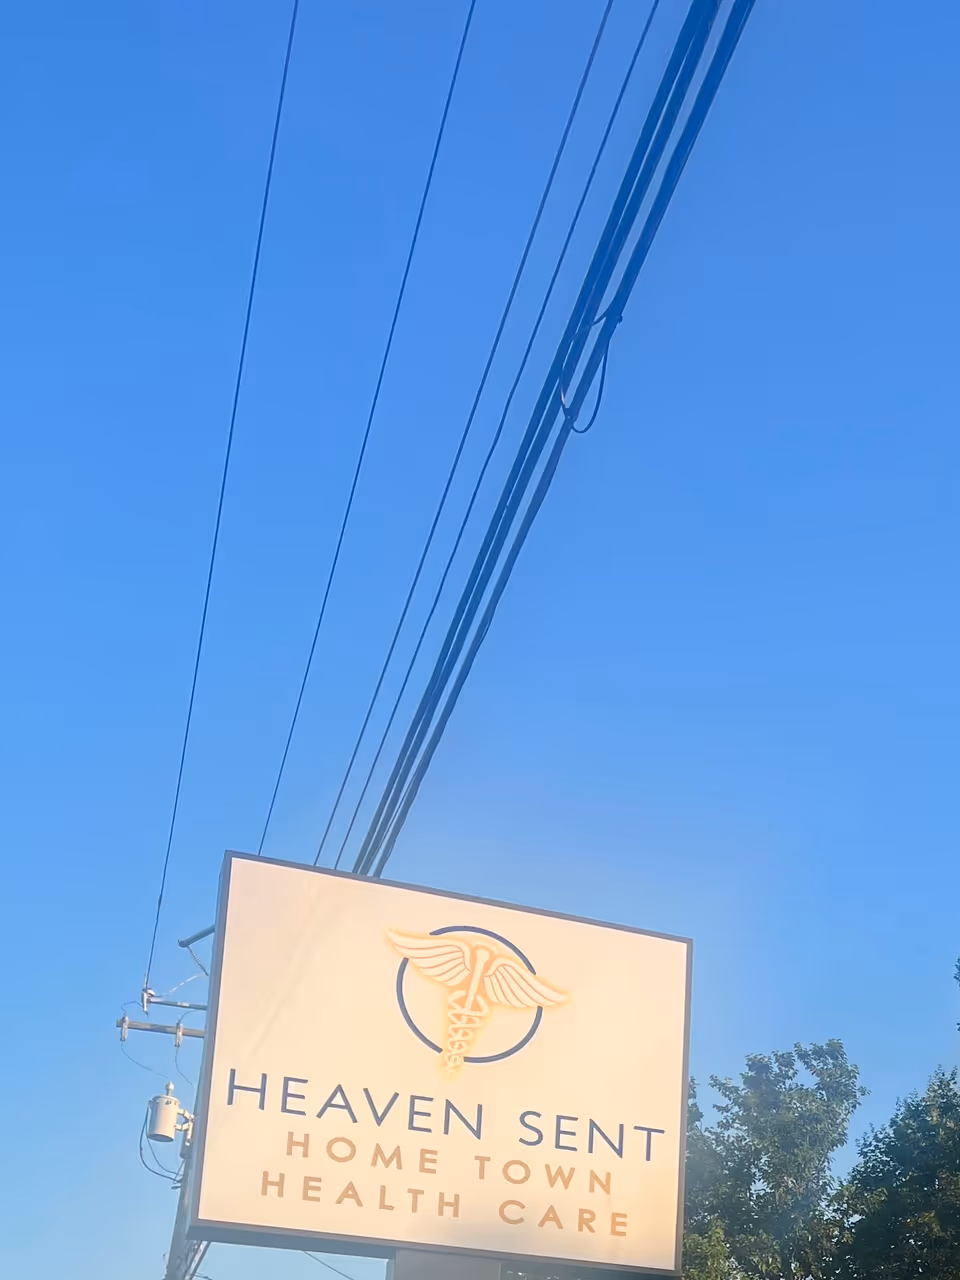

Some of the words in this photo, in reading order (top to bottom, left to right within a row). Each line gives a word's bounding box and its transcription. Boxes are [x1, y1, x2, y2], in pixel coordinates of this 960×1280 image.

[226, 1068, 483, 1140] HEAVEN
[518, 1110, 665, 1162] SENT
[286, 1131, 438, 1174] HOME
[474, 1155, 612, 1196] TOWN
[260, 1170, 461, 1218] HEALTH
[498, 1199, 628, 1237] CARE
